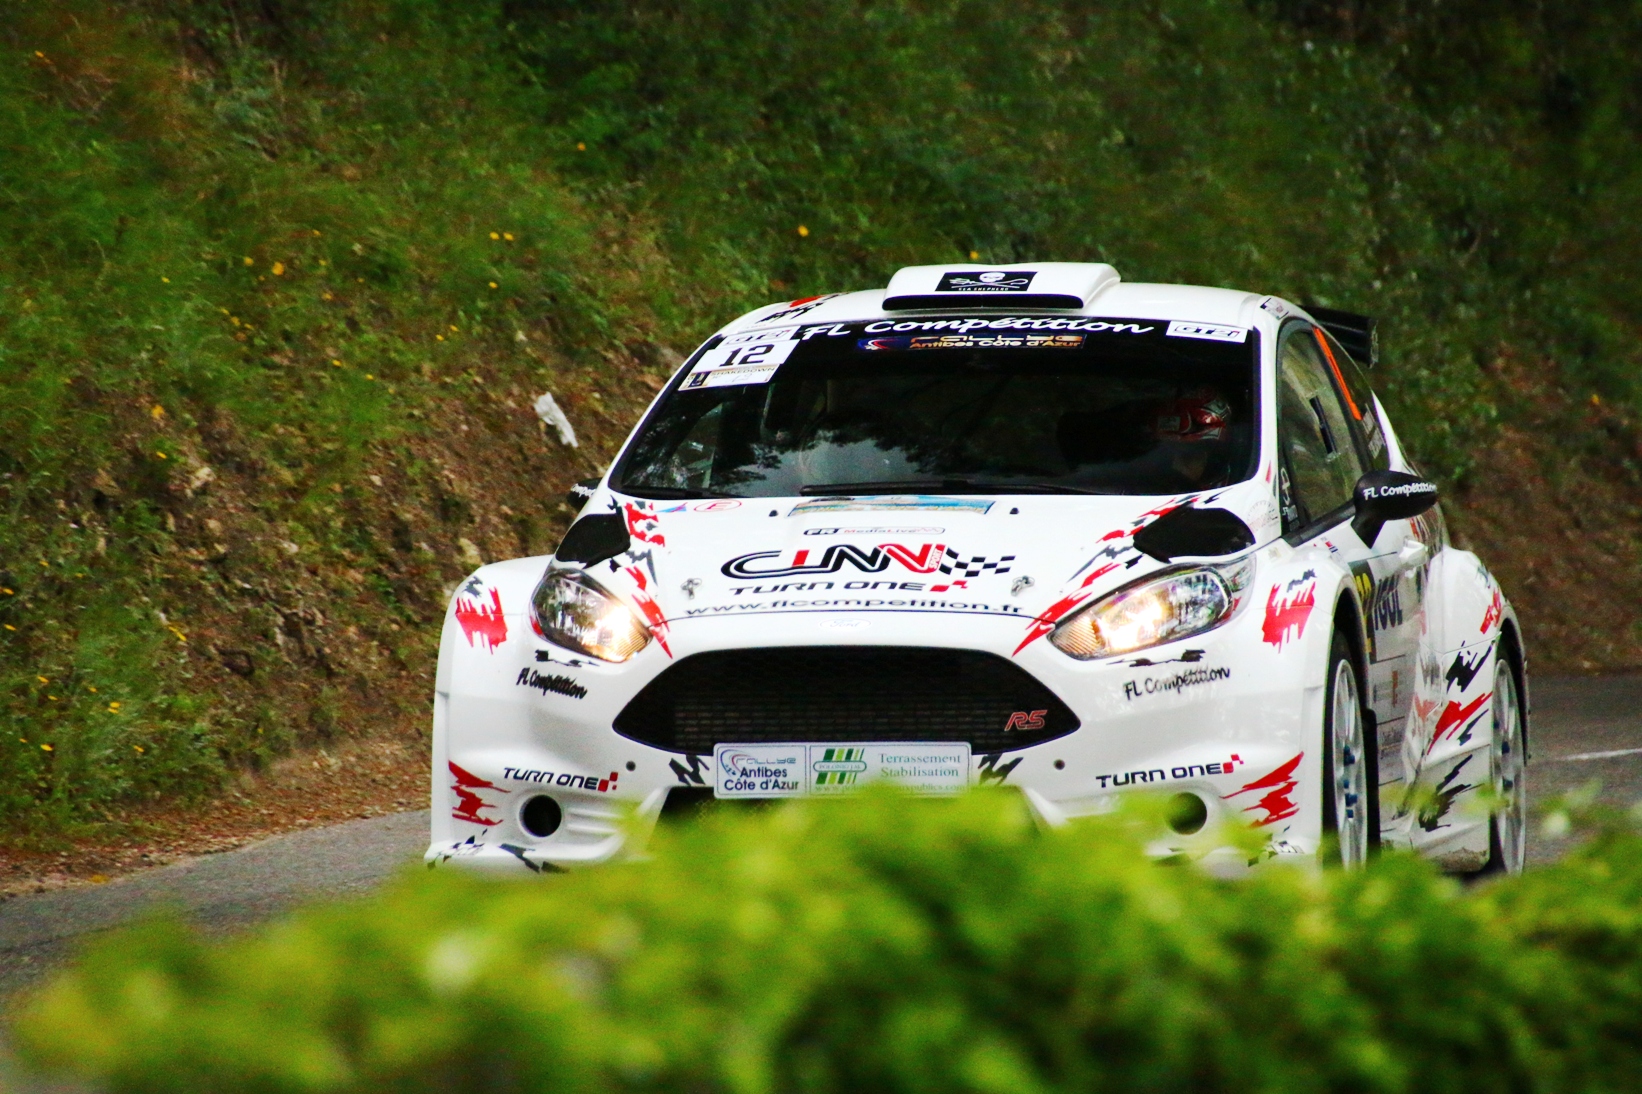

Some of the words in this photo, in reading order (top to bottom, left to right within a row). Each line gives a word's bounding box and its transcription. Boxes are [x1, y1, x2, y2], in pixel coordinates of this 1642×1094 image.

[801, 323, 851, 341] FL
[910, 341, 974, 349] Antibes
[1026, 340, 1081, 348] d'Azur
[719, 344, 775, 367] 12
[1362, 487, 1378, 501] FL
[928, 549, 943, 570] SPORT
[729, 581, 834, 595] TURN
[843, 581, 927, 592] ONE
[685, 598, 1024, 616] www.flcompetition.fr
[1123, 679, 1143, 700] FL
[1004, 709, 1048, 732] RS
[878, 753, 961, 763] Terrassement
[503, 767, 554, 784] TURN
[556, 774, 599, 791] ONE
[740, 767, 788, 778] Antibes
[881, 766, 959, 777] Stabilisation
[1095, 768, 1166, 788] TURN
[1171, 762, 1223, 779] ONE
[724, 778, 756, 791] Côte
[760, 779, 800, 791] d'Azur
